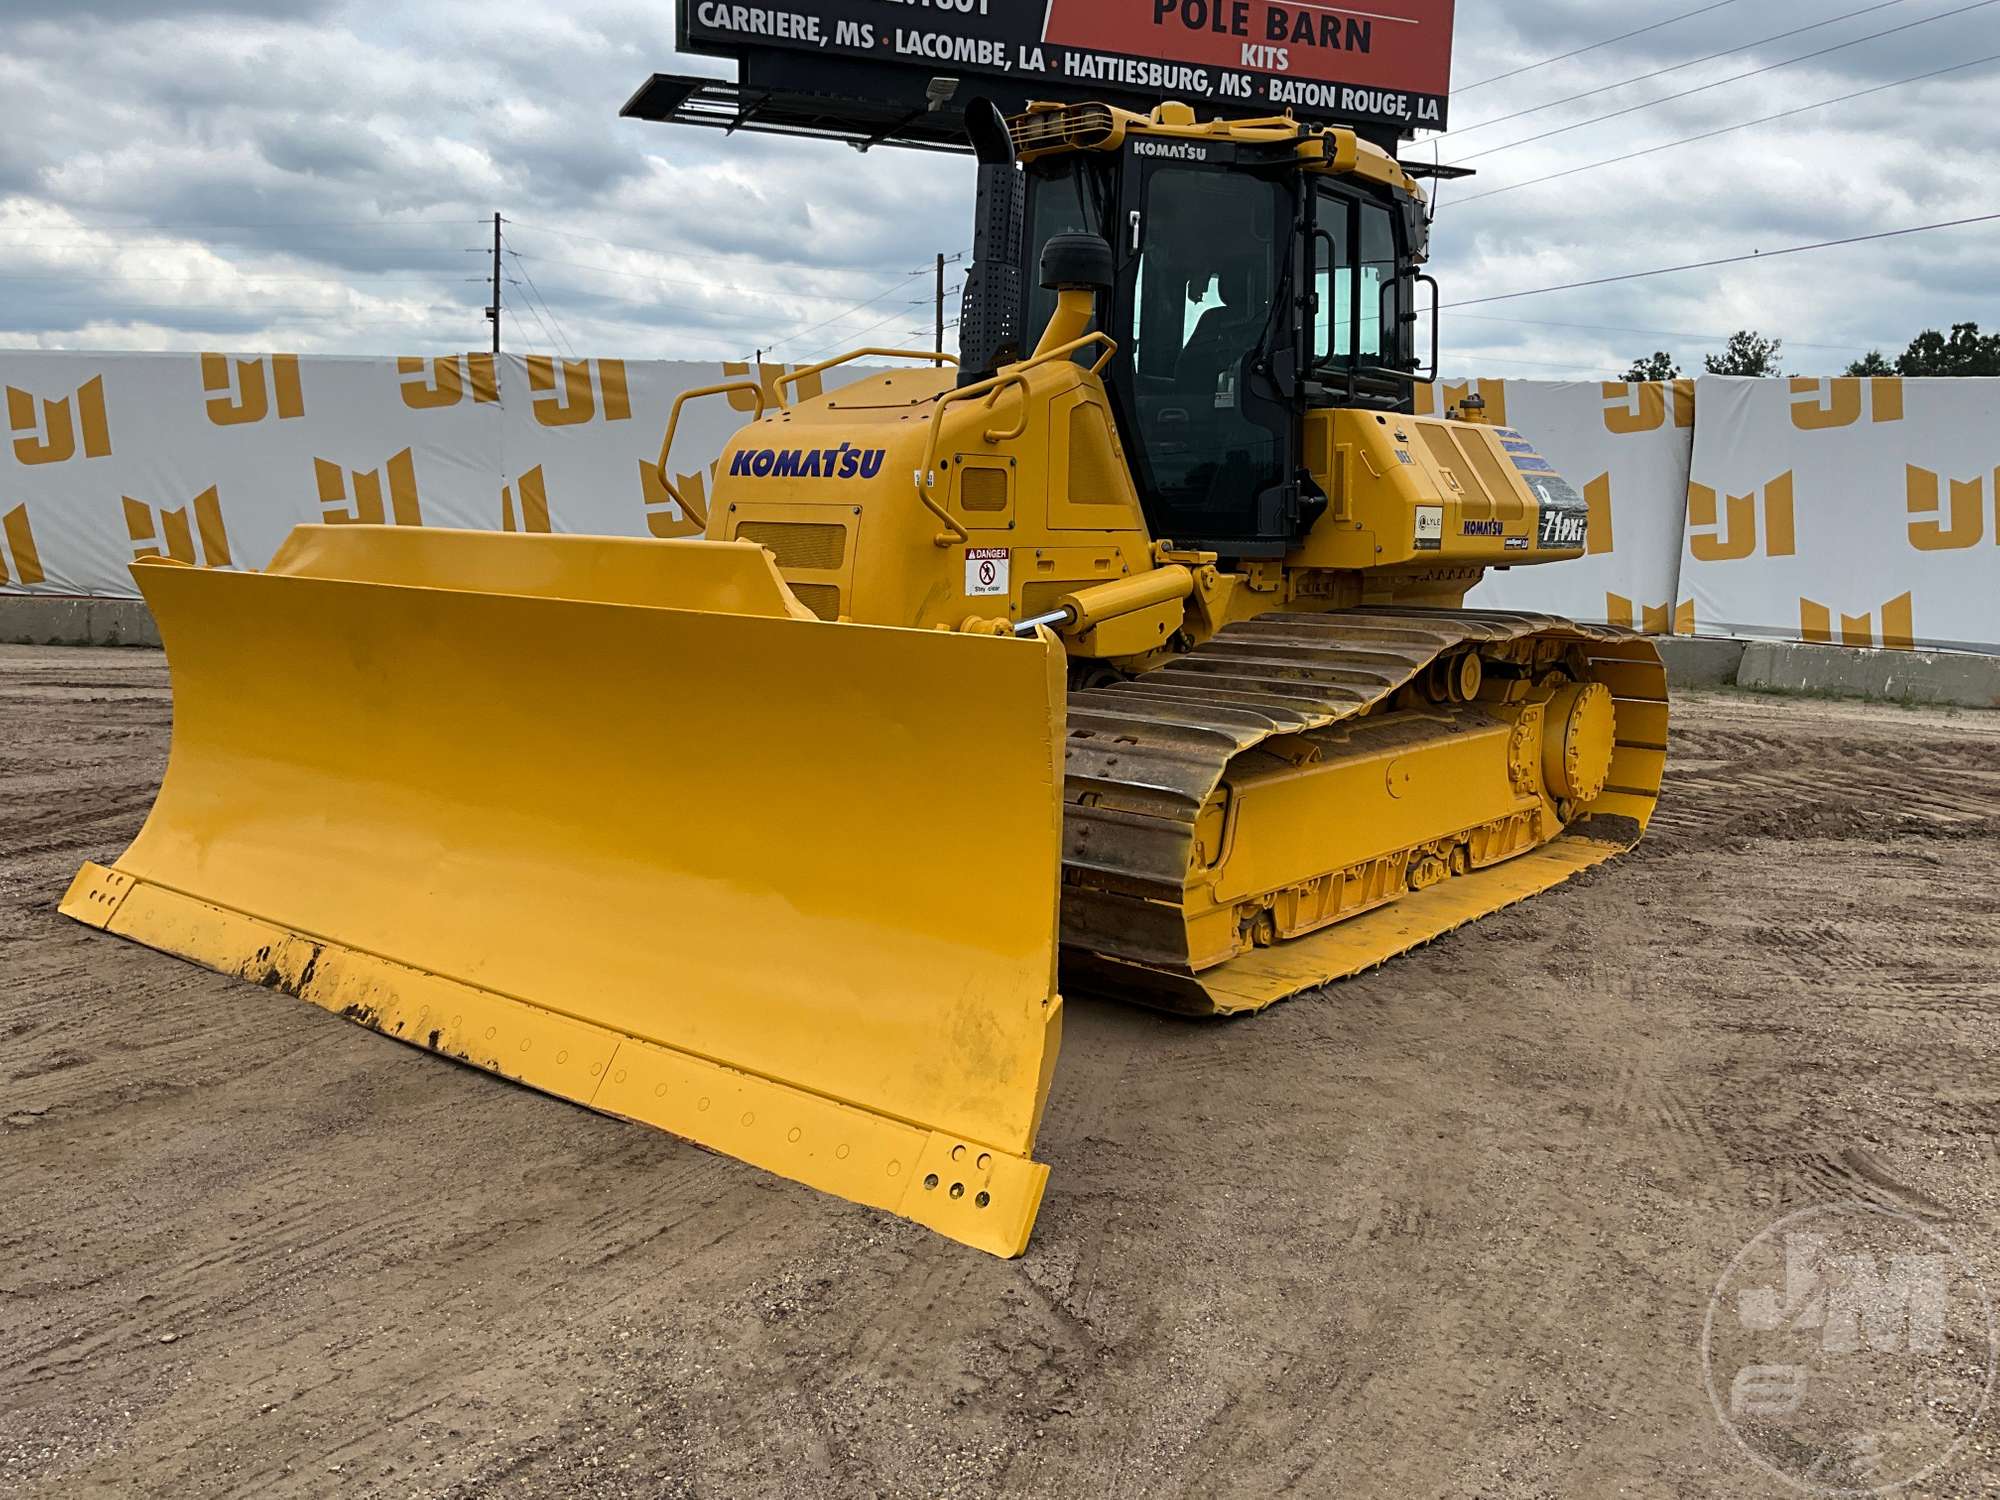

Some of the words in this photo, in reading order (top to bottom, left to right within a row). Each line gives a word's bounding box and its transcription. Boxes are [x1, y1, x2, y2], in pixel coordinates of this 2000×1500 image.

[1154, 0, 1249, 37] POLE
[1266, 6, 1371, 54] BARN
[697, 1, 829, 48] CARRIERE,
[835, 20, 874, 49] MS
[895, 28, 1013, 71] LACOMBE,
[1019, 46, 1045, 72] LA
[1064, 52, 1213, 98] HATTIESBURG,
[1219, 74, 1252, 98] MS
[1269, 79, 1335, 108] BATON
[1341, 88, 1412, 121] ROUGE,
[1417, 97, 1439, 121] LA
[1241, 43, 1289, 70] KITS
[1133, 141, 1207, 161] KOMATSU
[729, 442, 886, 479] KOMATSU
[1463, 517, 1504, 535] KOMATSU
[976, 549, 1006, 558] DANGER
